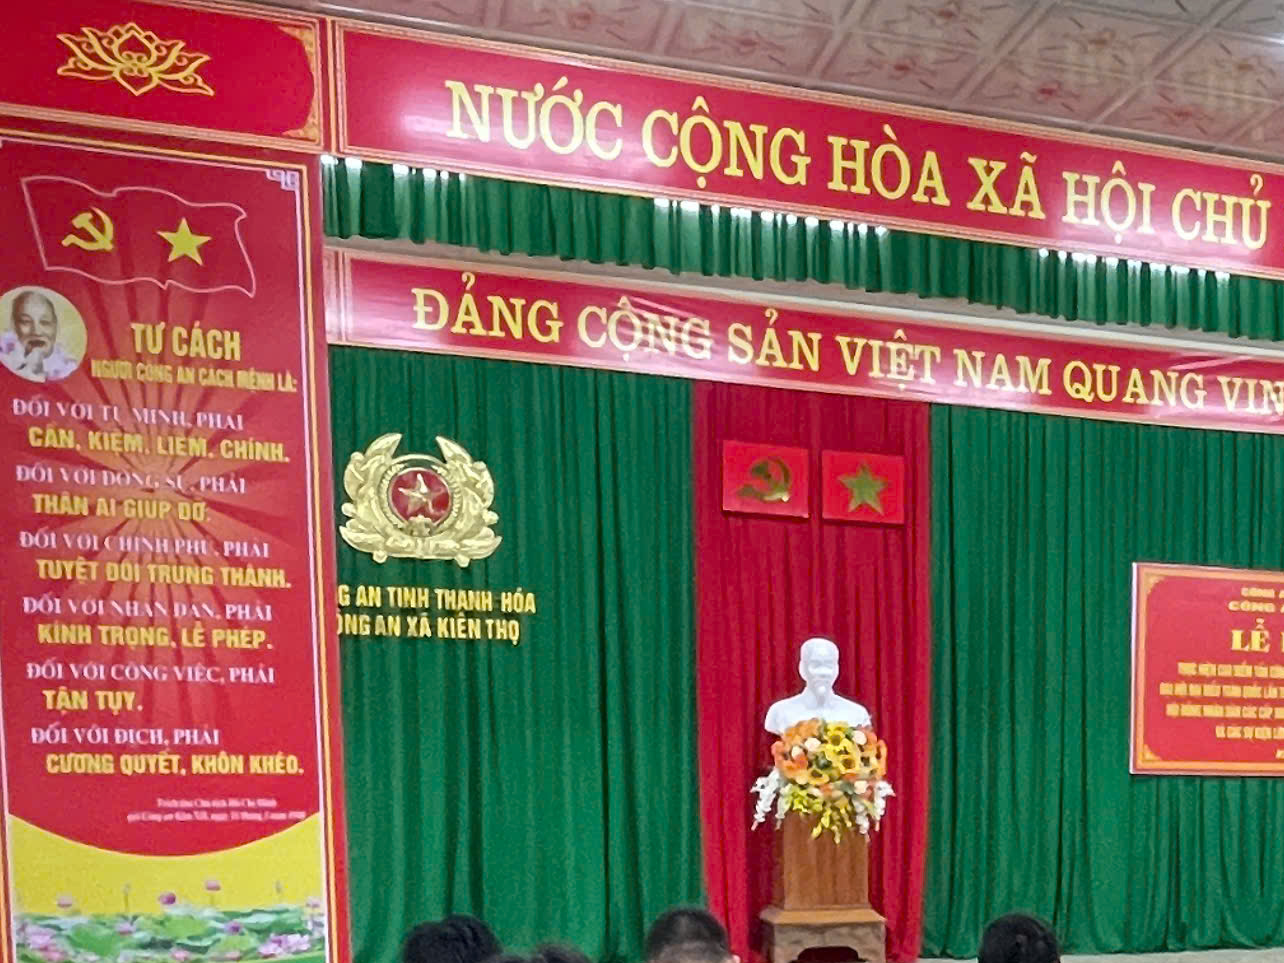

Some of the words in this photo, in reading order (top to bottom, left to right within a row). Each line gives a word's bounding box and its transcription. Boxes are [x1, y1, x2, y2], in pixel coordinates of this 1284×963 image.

[445, 76, 623, 160] NƯỚC
[642, 96, 810, 188] CỘNG
[827, 124, 950, 204] HÒA
[966, 151, 1046, 220] XÃ
[1062, 160, 1156, 244] HỘI
[1172, 174, 1271, 250] CHỦ
[130, 321, 166, 355] TƯ
[172, 320, 241, 362] CÁCH
[411, 272, 564, 344] ĐẢNG
[577, 296, 712, 362] CỘNG
[727, 308, 821, 371] SẢN
[835, 329, 941, 390] VIỆT
[953, 348, 1052, 396] NAM
[1063, 360, 1205, 410] QUANG
[177, 366, 195, 384] AN
[147, 564, 214, 585] TRUNG
[355, 585, 382, 608] AN
[434, 588, 493, 612] THANH
[375, 615, 401, 637] AN
[437, 612, 481, 640] KIÊN
[485, 619, 520, 646] THỌ
[1231, 617, 1270, 653] LỄ
[42, 686, 88, 716] TẬN
[192, 750, 244, 774] KHÔN
